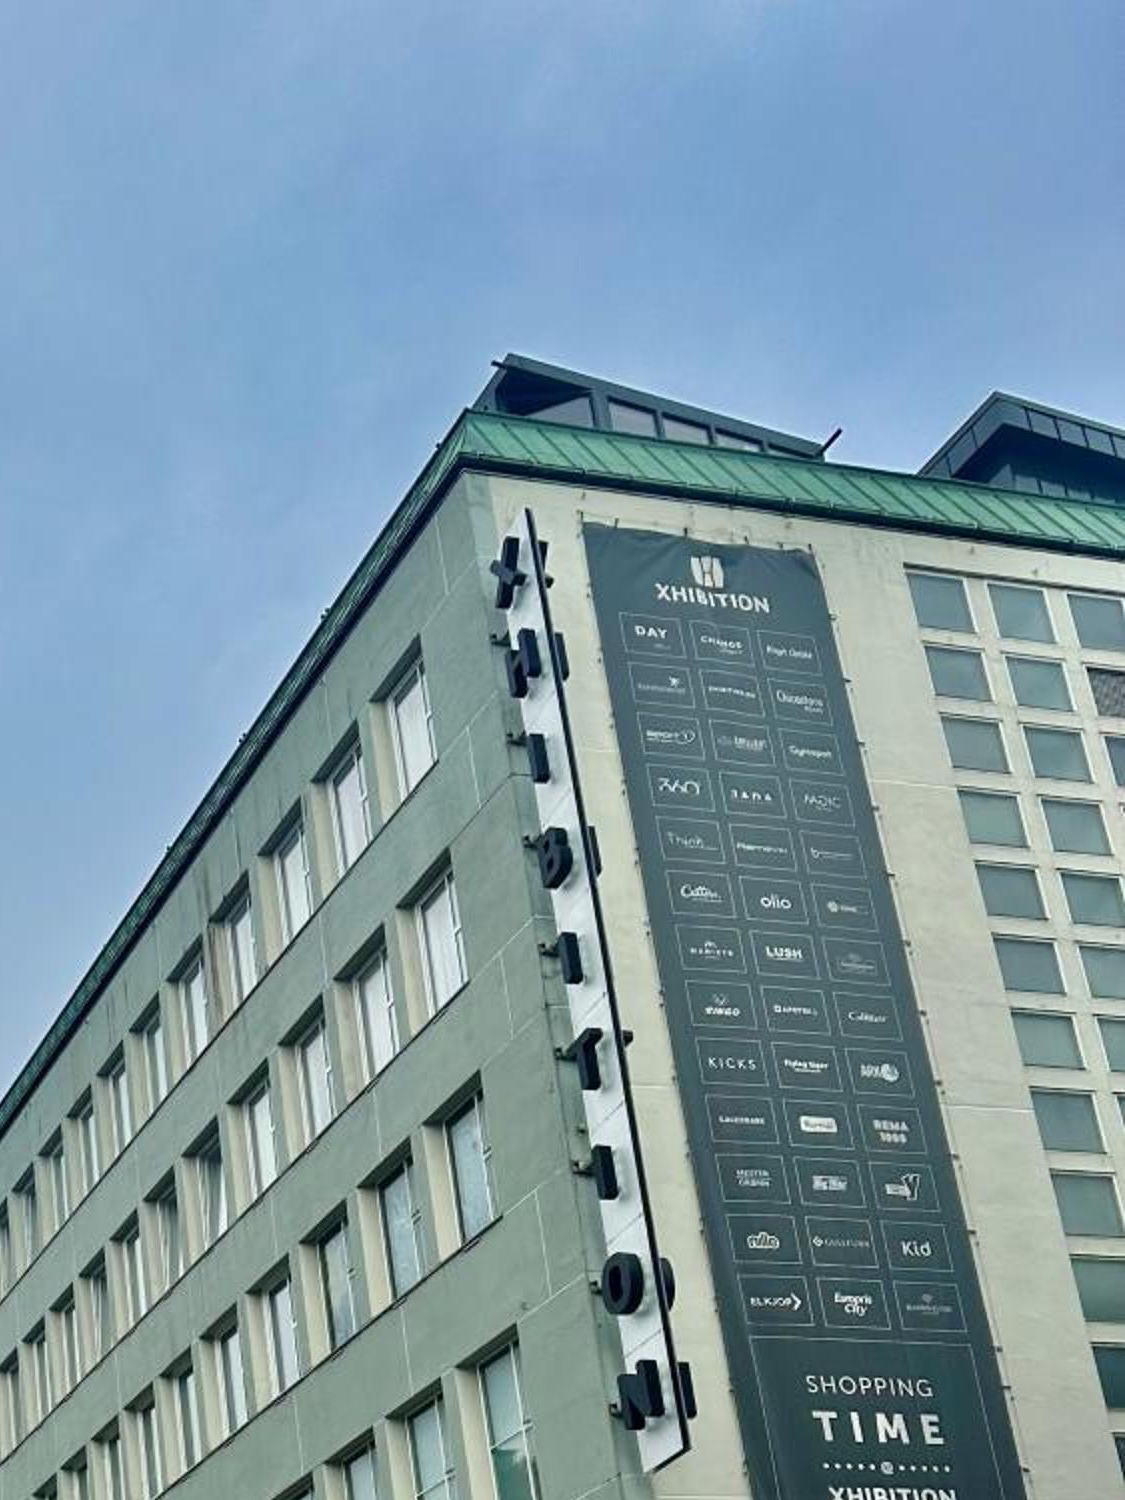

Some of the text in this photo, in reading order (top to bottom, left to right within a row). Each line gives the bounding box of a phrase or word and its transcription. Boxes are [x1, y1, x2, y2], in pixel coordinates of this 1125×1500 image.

[655, 583, 771, 614] XHIBITION
[634, 625, 668, 640] DAY
[765, 945, 804, 960] LUSH
[708, 1056, 757, 1071] KICKS
[900, 1240, 933, 1257] Kid
[844, 1302, 868, 1317] City
[806, 1375, 934, 1398] SHOPPING
[811, 1410, 945, 1445] TIME
